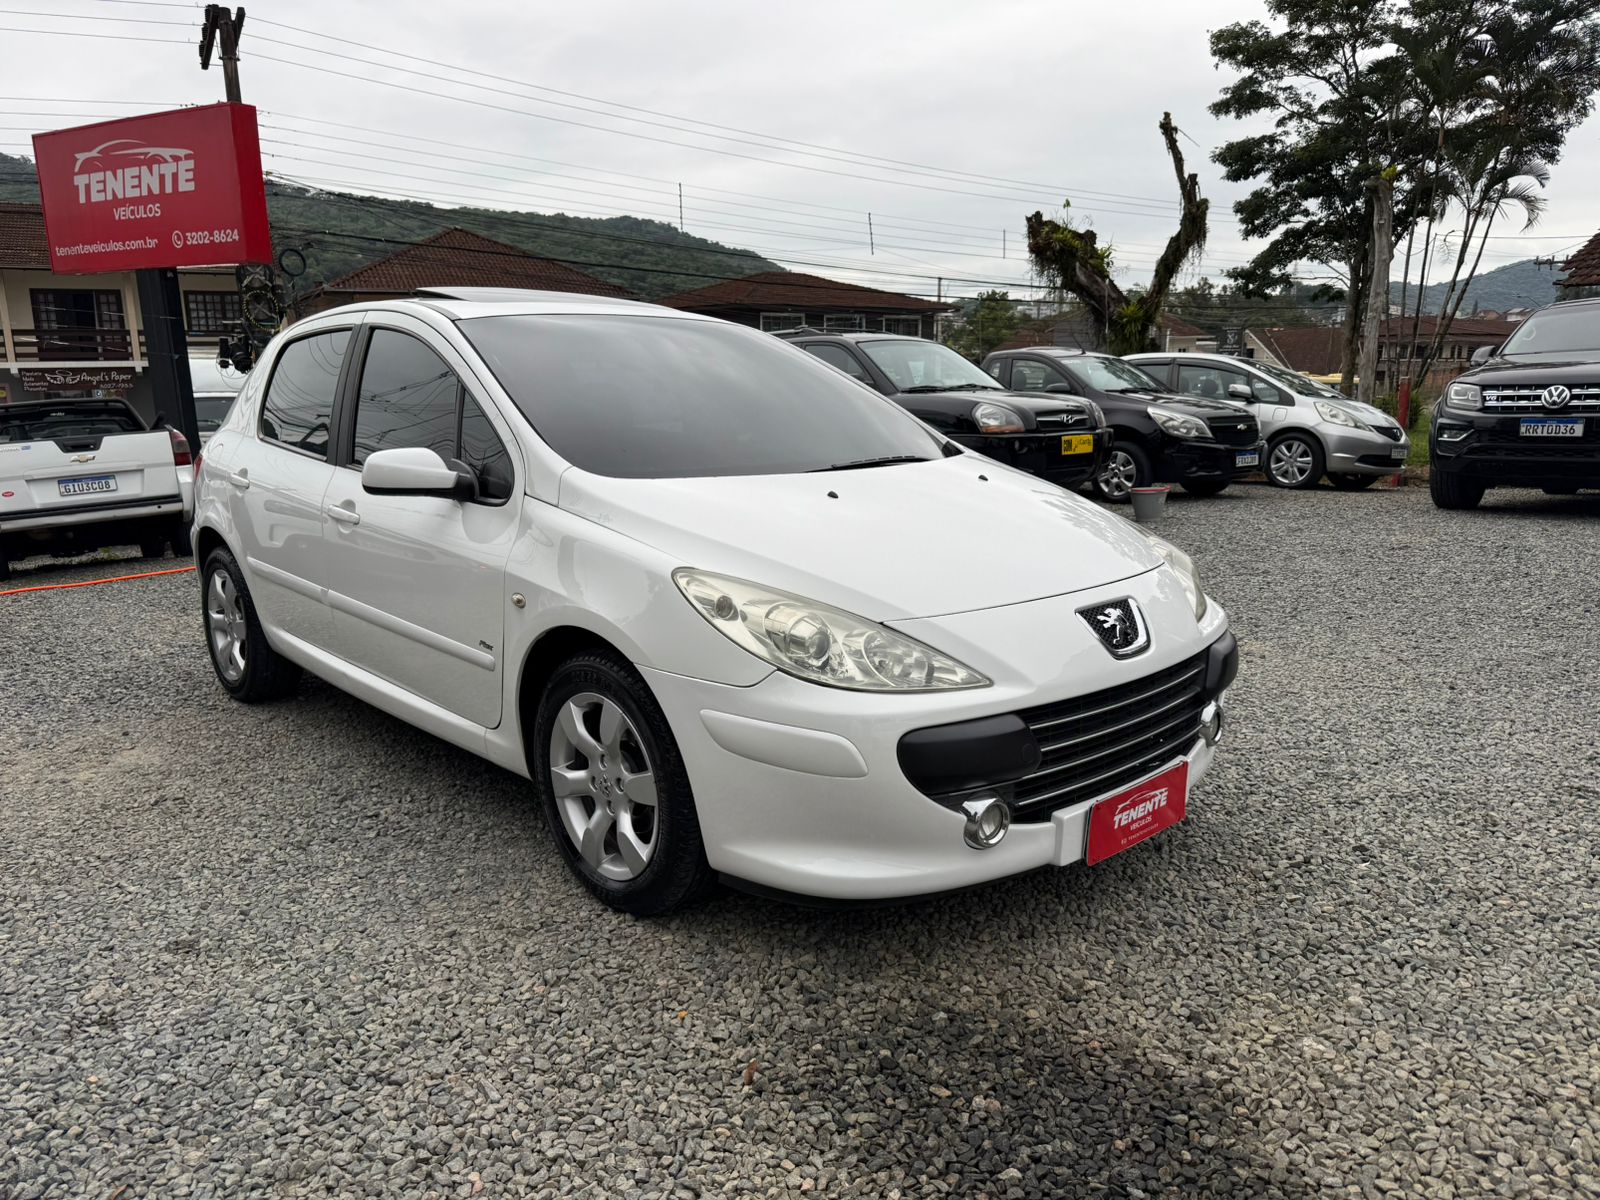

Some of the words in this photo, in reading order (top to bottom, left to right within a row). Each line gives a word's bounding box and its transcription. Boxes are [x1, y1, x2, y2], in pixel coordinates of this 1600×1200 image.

[73, 160, 196, 204] TENENTE
[113, 203, 161, 220] VEÍCULOS
[185, 228, 240, 246] 3202-8624
[81, 371, 109, 385] Angel's
[111, 370, 132, 382] Paper
[1113, 793, 1168, 829] TENENTE
